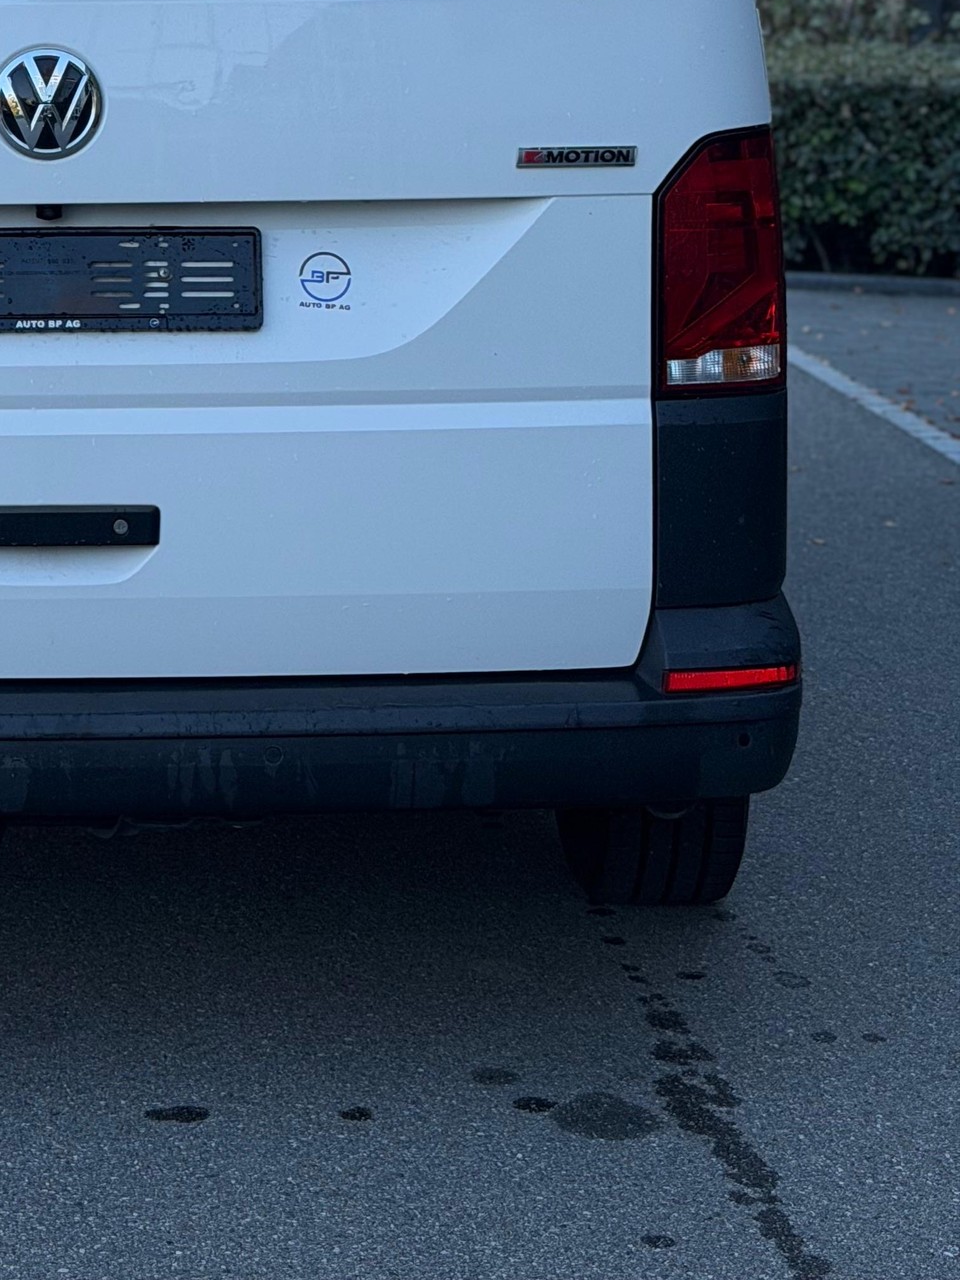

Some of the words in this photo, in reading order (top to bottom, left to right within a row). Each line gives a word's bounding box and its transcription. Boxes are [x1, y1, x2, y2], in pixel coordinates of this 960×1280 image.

[16, 320, 45, 328] AUTO
[48, 320, 62, 328] BP
[65, 320, 81, 328] AG
